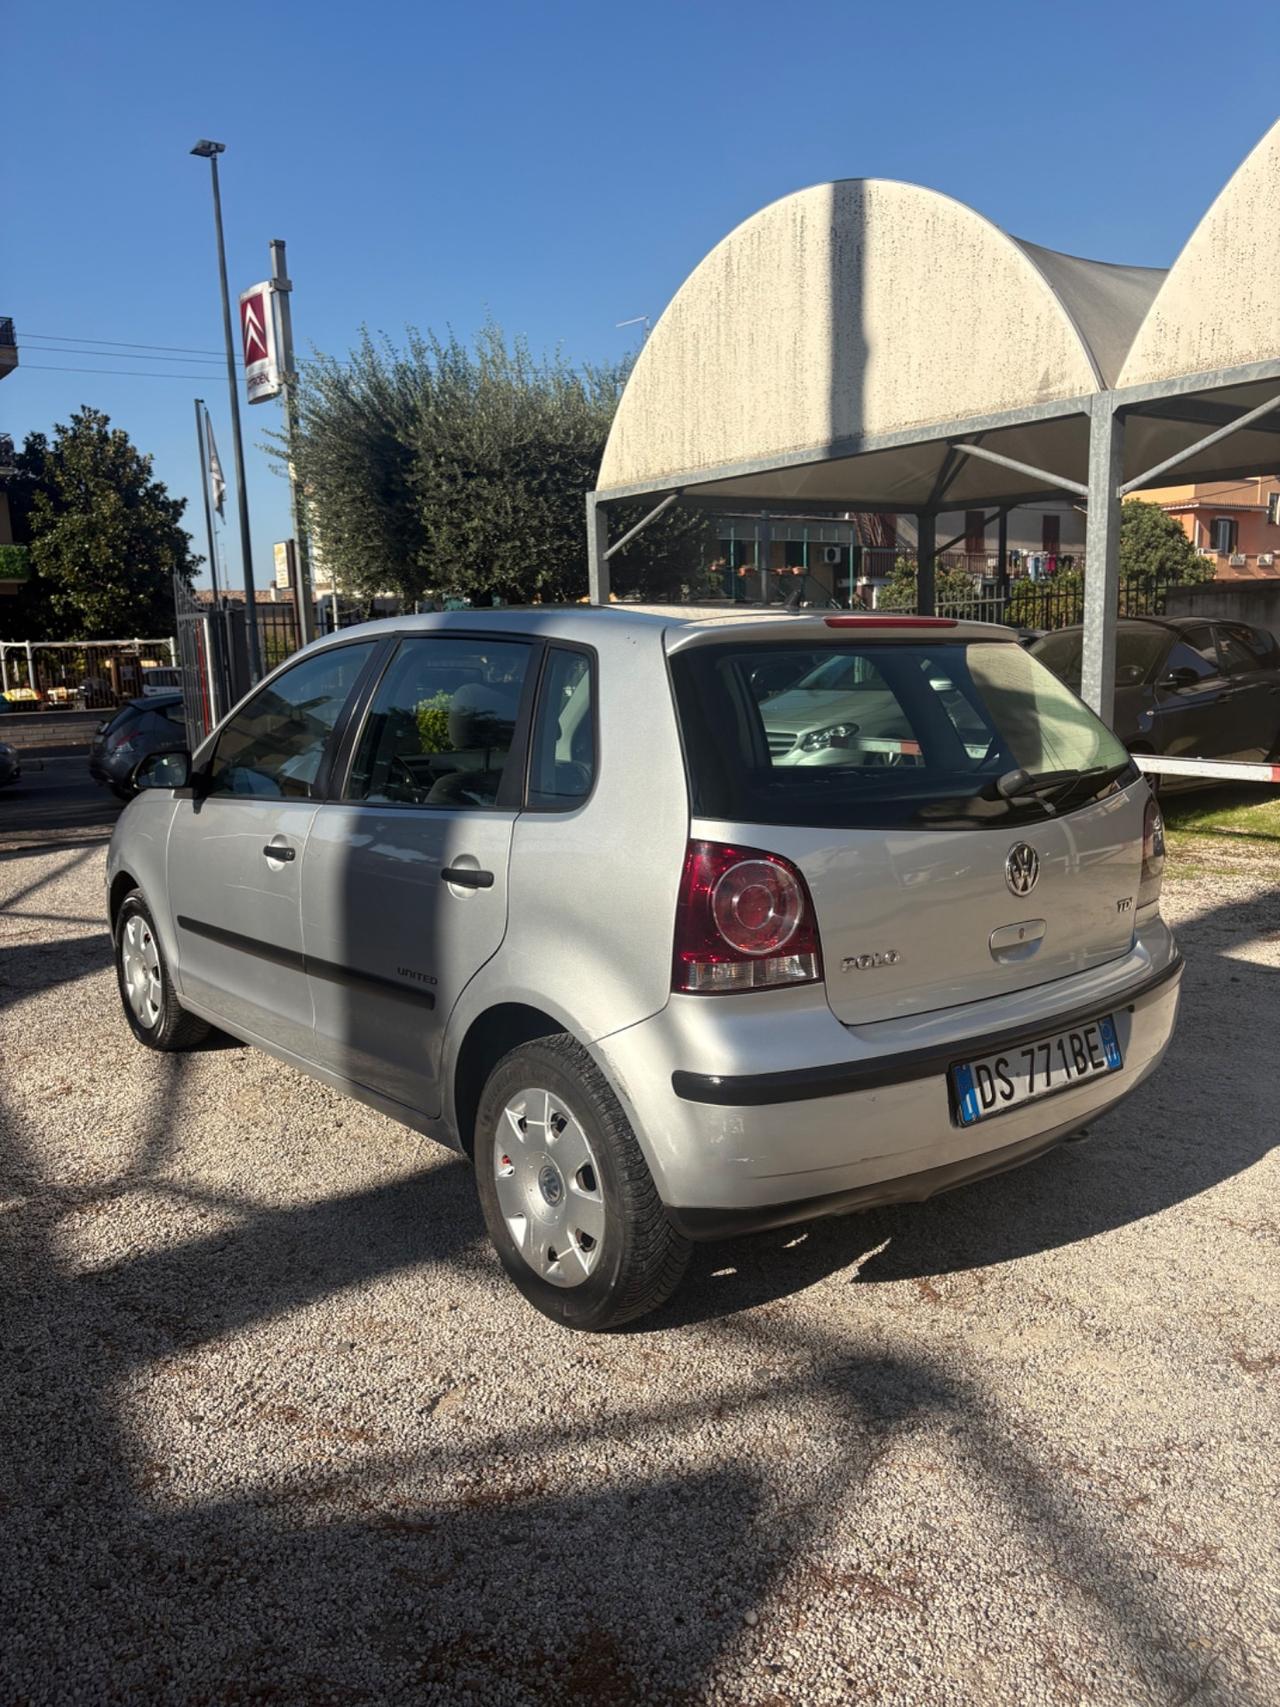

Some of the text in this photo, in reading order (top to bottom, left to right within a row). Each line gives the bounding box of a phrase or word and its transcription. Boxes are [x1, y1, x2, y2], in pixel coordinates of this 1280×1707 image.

[841, 950, 901, 973] POLO
[975, 1027, 1105, 1110] DS 771BE
